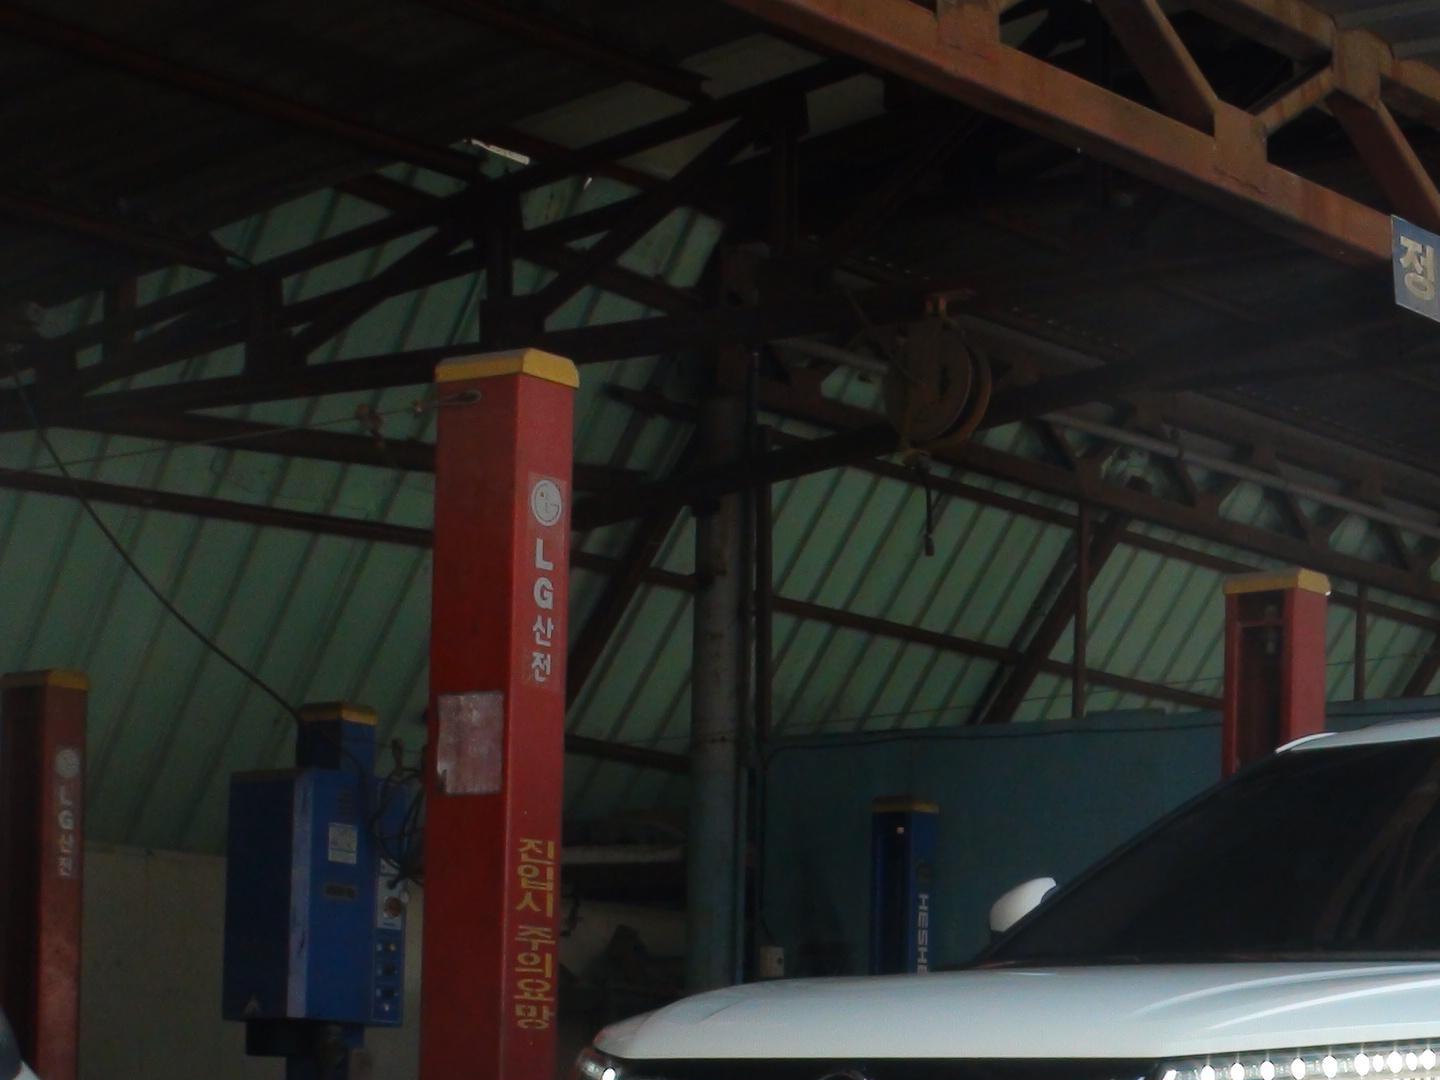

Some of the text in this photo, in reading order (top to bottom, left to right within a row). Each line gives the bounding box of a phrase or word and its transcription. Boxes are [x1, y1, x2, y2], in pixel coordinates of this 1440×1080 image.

[531, 537, 555, 684] LG산전
[513, 838, 556, 1030] 진입시 주의요망
